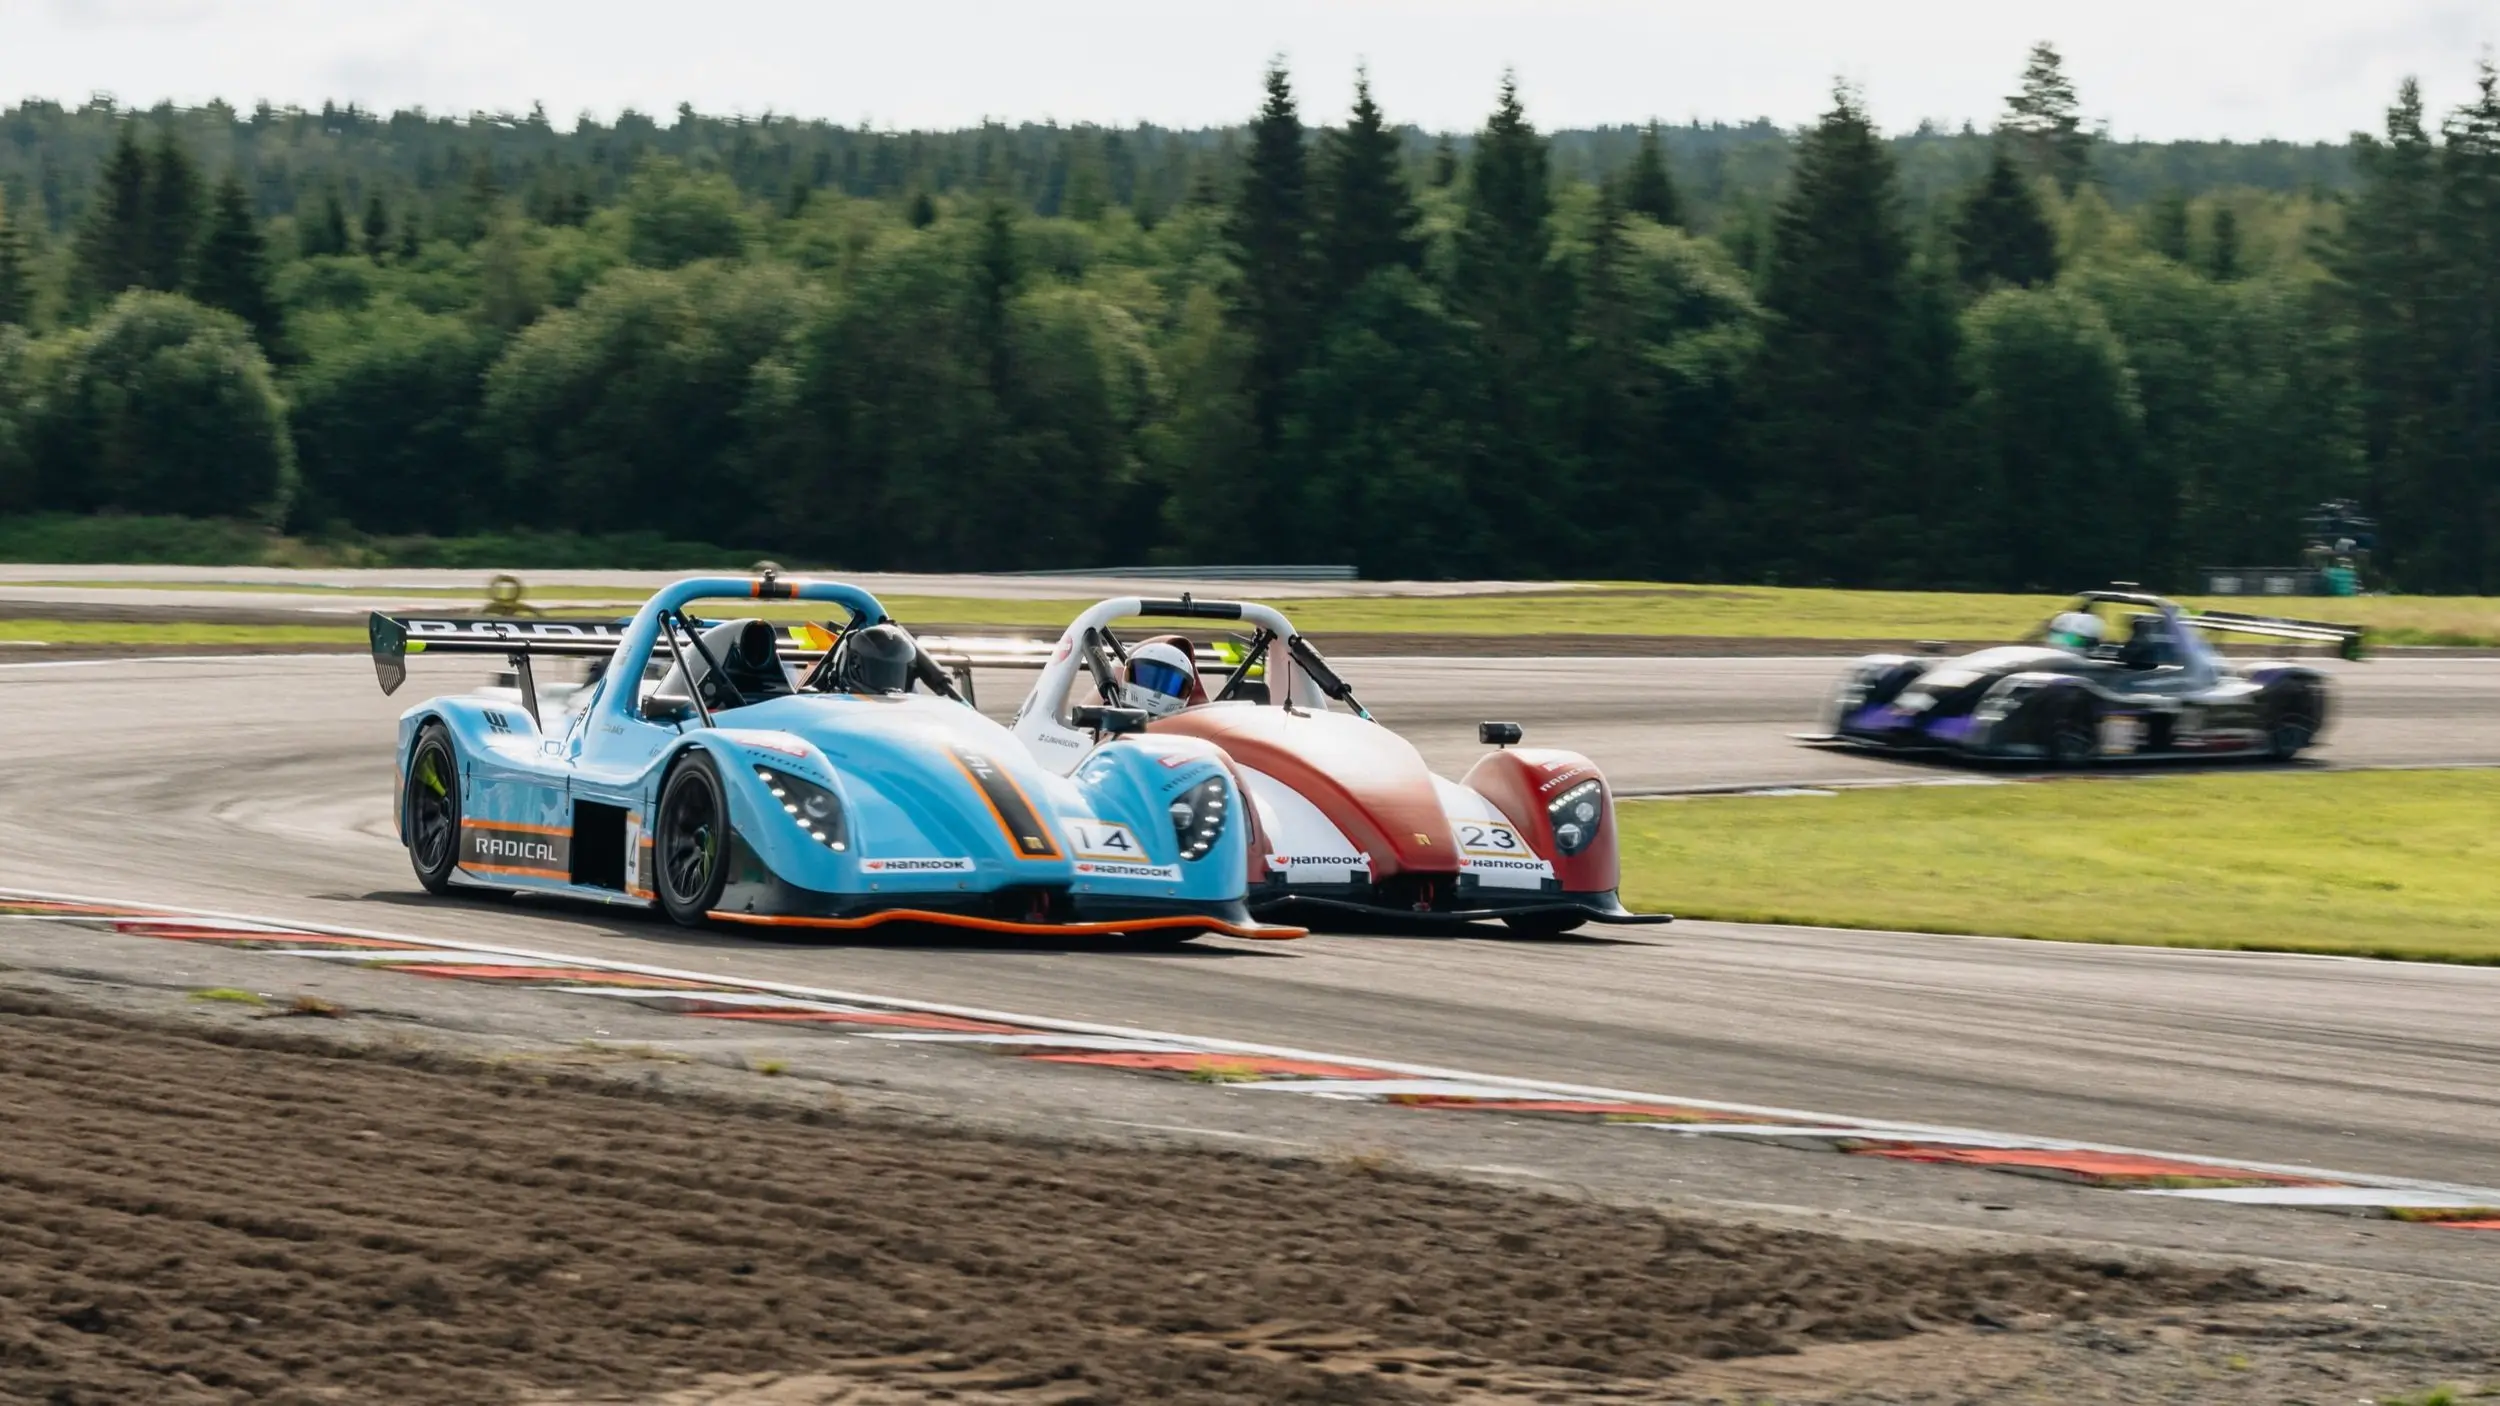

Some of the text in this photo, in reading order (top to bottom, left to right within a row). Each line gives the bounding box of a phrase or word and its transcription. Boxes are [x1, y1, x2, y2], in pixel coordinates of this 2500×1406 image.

[1540, 766, 1596, 792] RADIC
[475, 837, 558, 862] RADICAL
[1074, 826, 1132, 851] 14
[1461, 826, 1516, 849] 23
